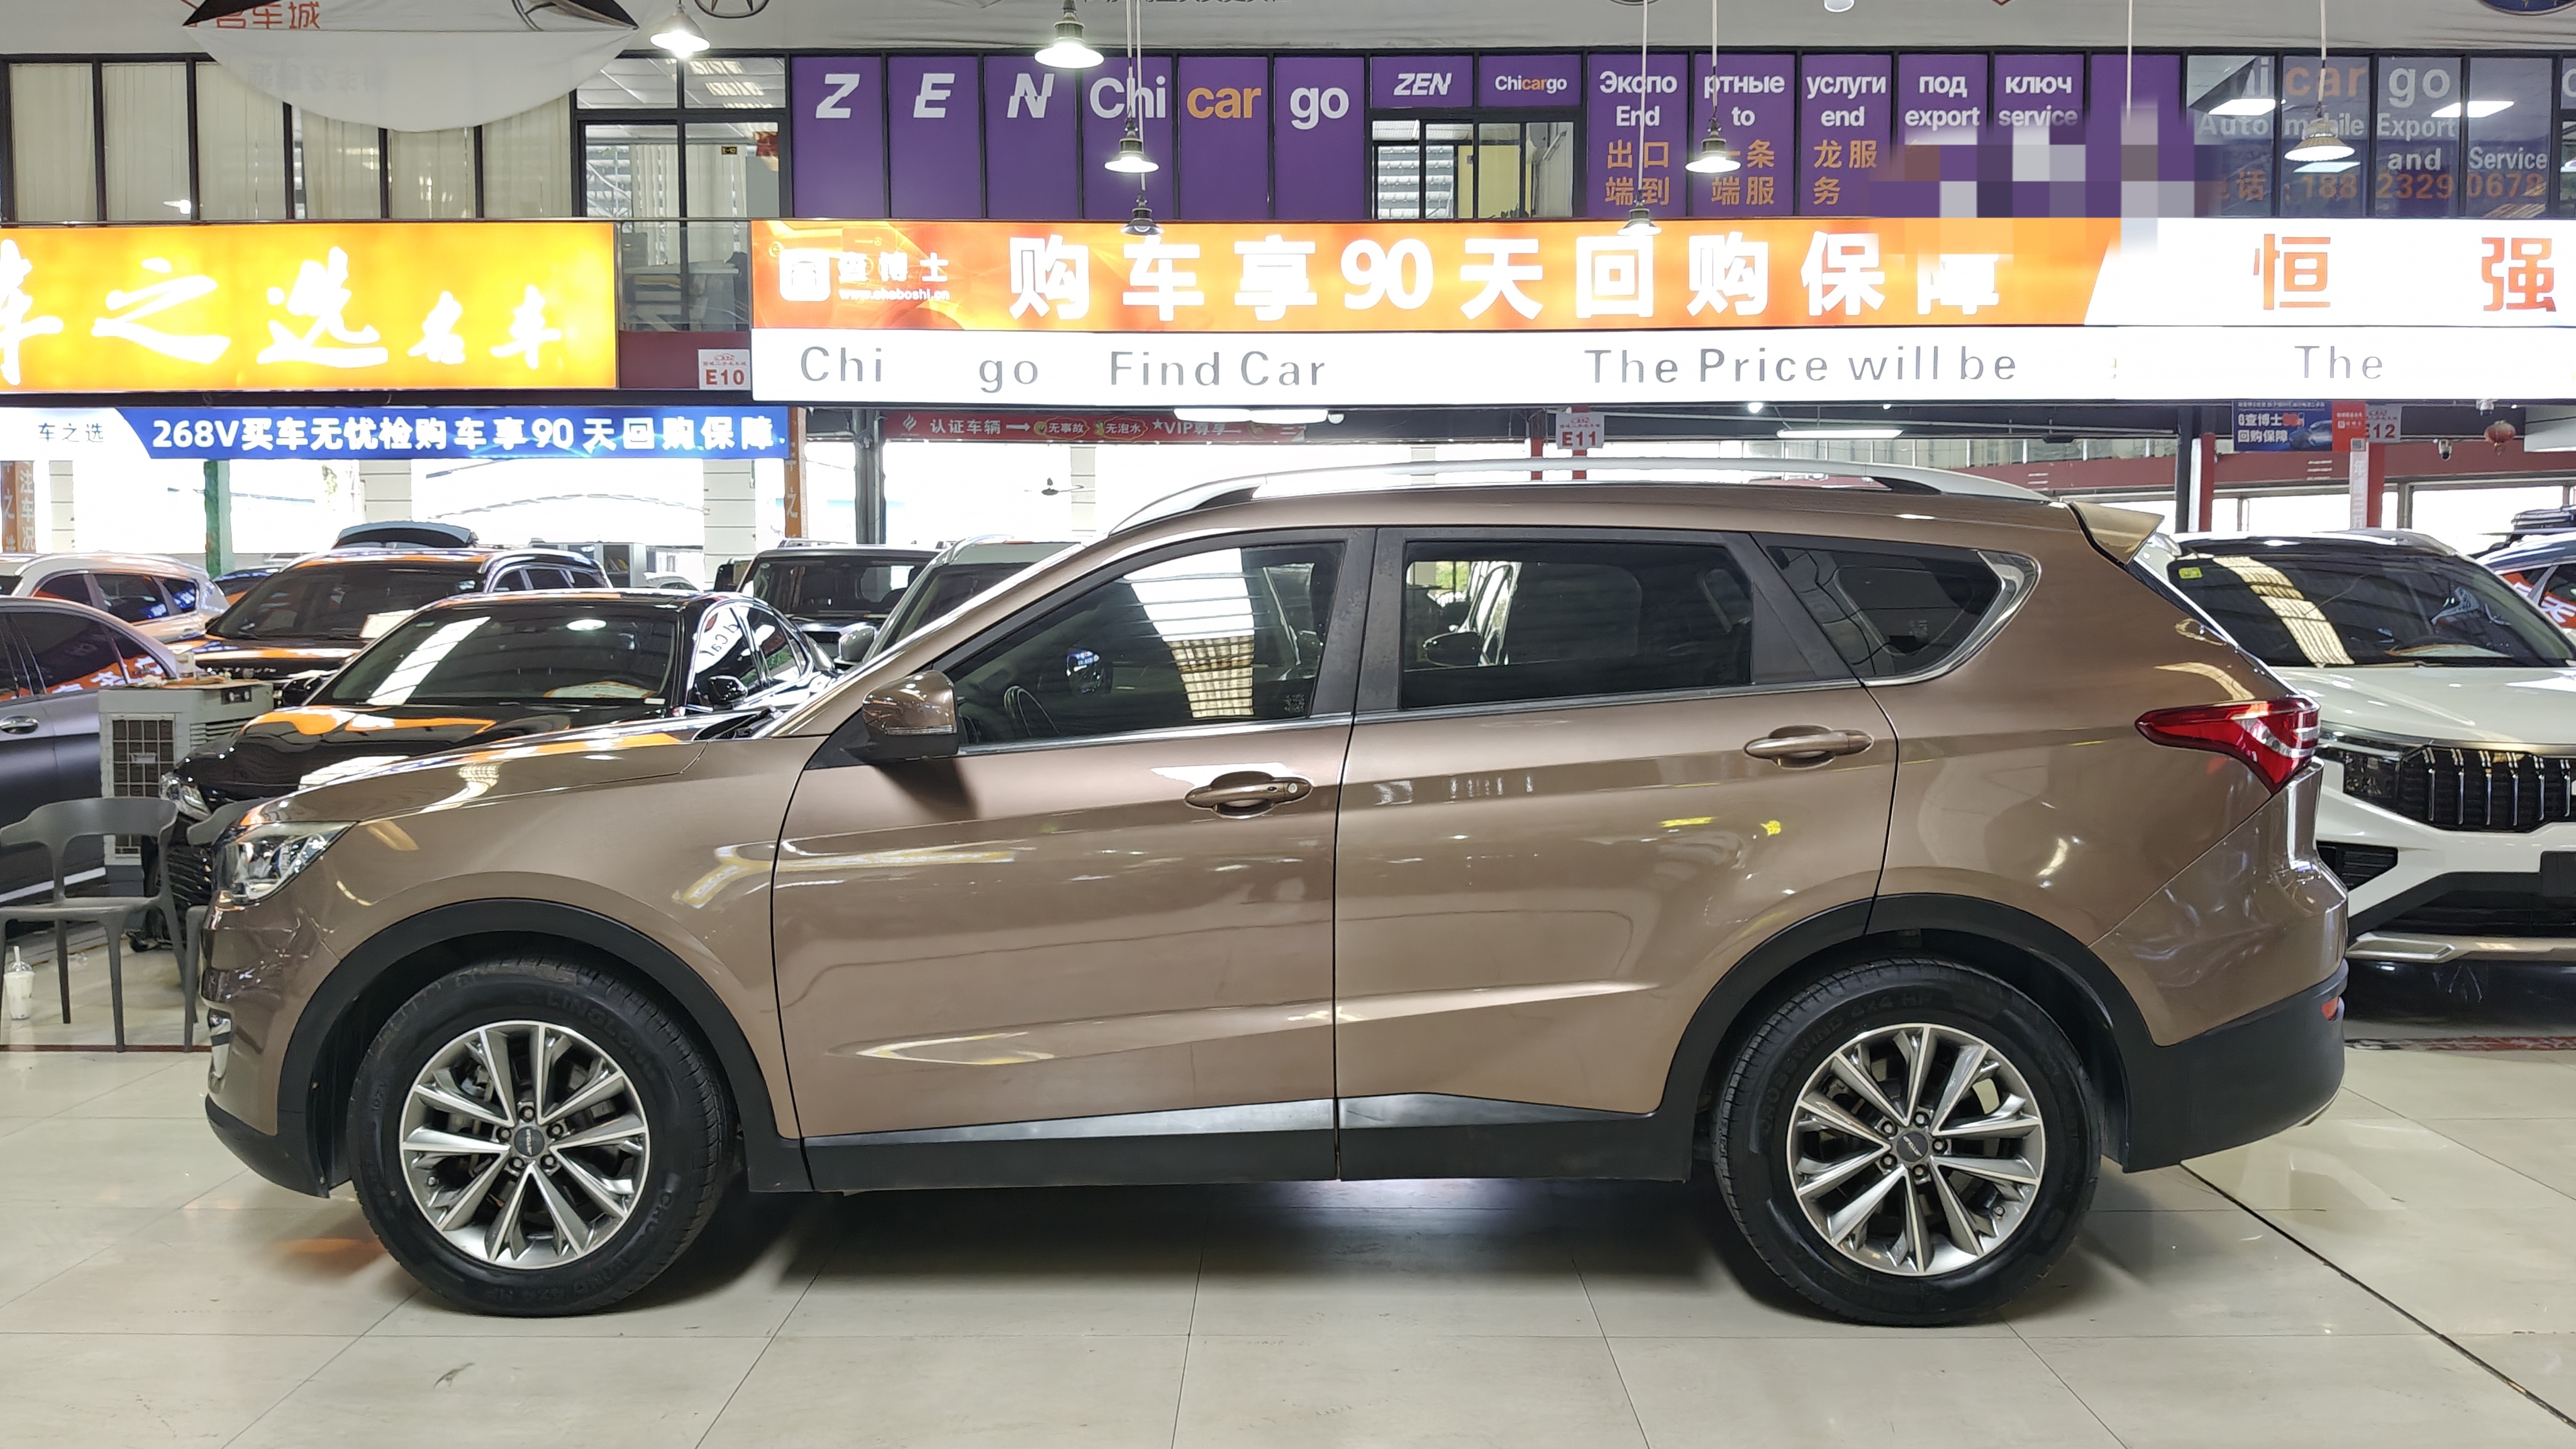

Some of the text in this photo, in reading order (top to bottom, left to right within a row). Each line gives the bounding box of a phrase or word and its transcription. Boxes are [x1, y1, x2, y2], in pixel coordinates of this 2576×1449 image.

[1393, 72, 1452, 96] ZEN
[1494, 75, 1568, 95] Chicargo
[1599, 71, 2072, 99] Экспо ртные услуги под ключ
[2285, 67, 2367, 97] car
[2389, 67, 2450, 108] go
[816, 73, 1350, 130] Z E N Chi car go
[1616, 105, 2079, 131] End to end export service
[2284, 113, 2365, 136] mile
[2377, 113, 2457, 142] Export
[1607, 140, 1669, 169] 出口
[1813, 139, 1878, 169] 龙服
[2387, 146, 2548, 171] and Service
[1605, 176, 1841, 206] 端到 端服 务
[2375, 172, 2453, 199] 2329
[800, 346, 1326, 394] Chi go Find Car
[1584, 345, 2017, 383] The Price will be
[2294, 346, 2384, 379] The
[706, 369, 745, 385] E10
[930, 418, 1001, 435] 认证车辆
[1562, 431, 1596, 446] E11
